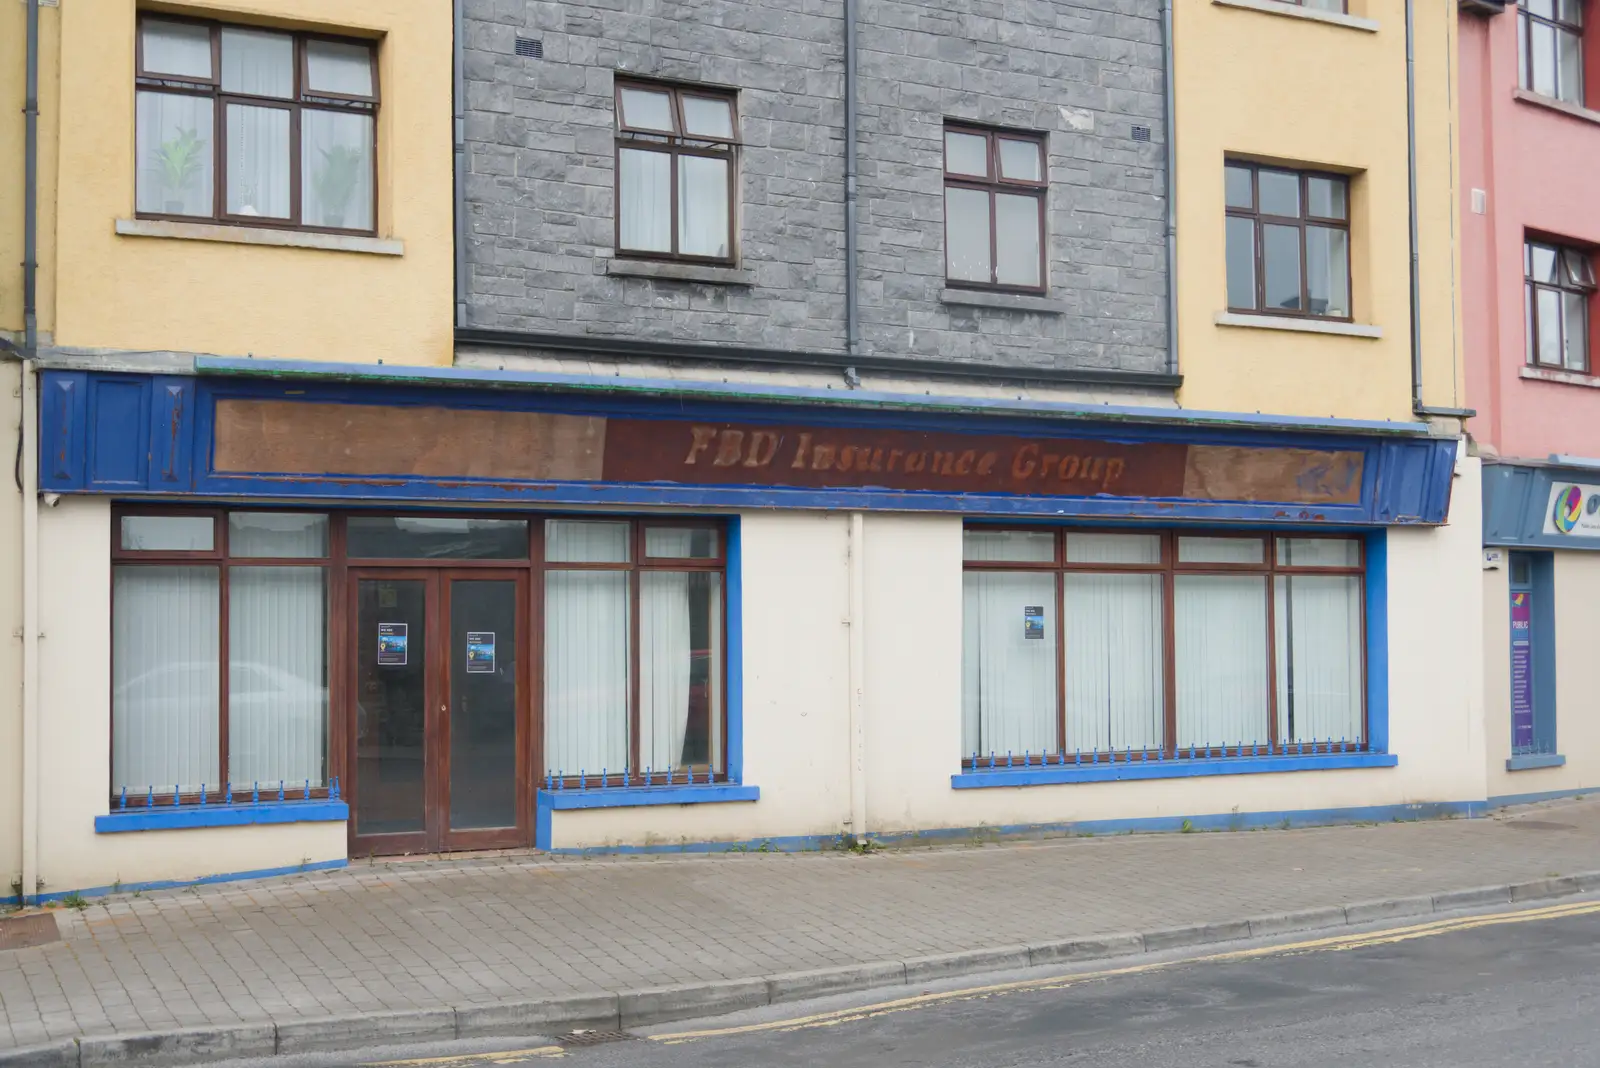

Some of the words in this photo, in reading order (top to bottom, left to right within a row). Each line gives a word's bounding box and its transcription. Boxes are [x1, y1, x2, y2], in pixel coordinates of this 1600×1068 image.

[684, 425, 778, 468] FBD
[791, 432, 997, 476] Insurance
[1012, 443, 1125, 490] Group
